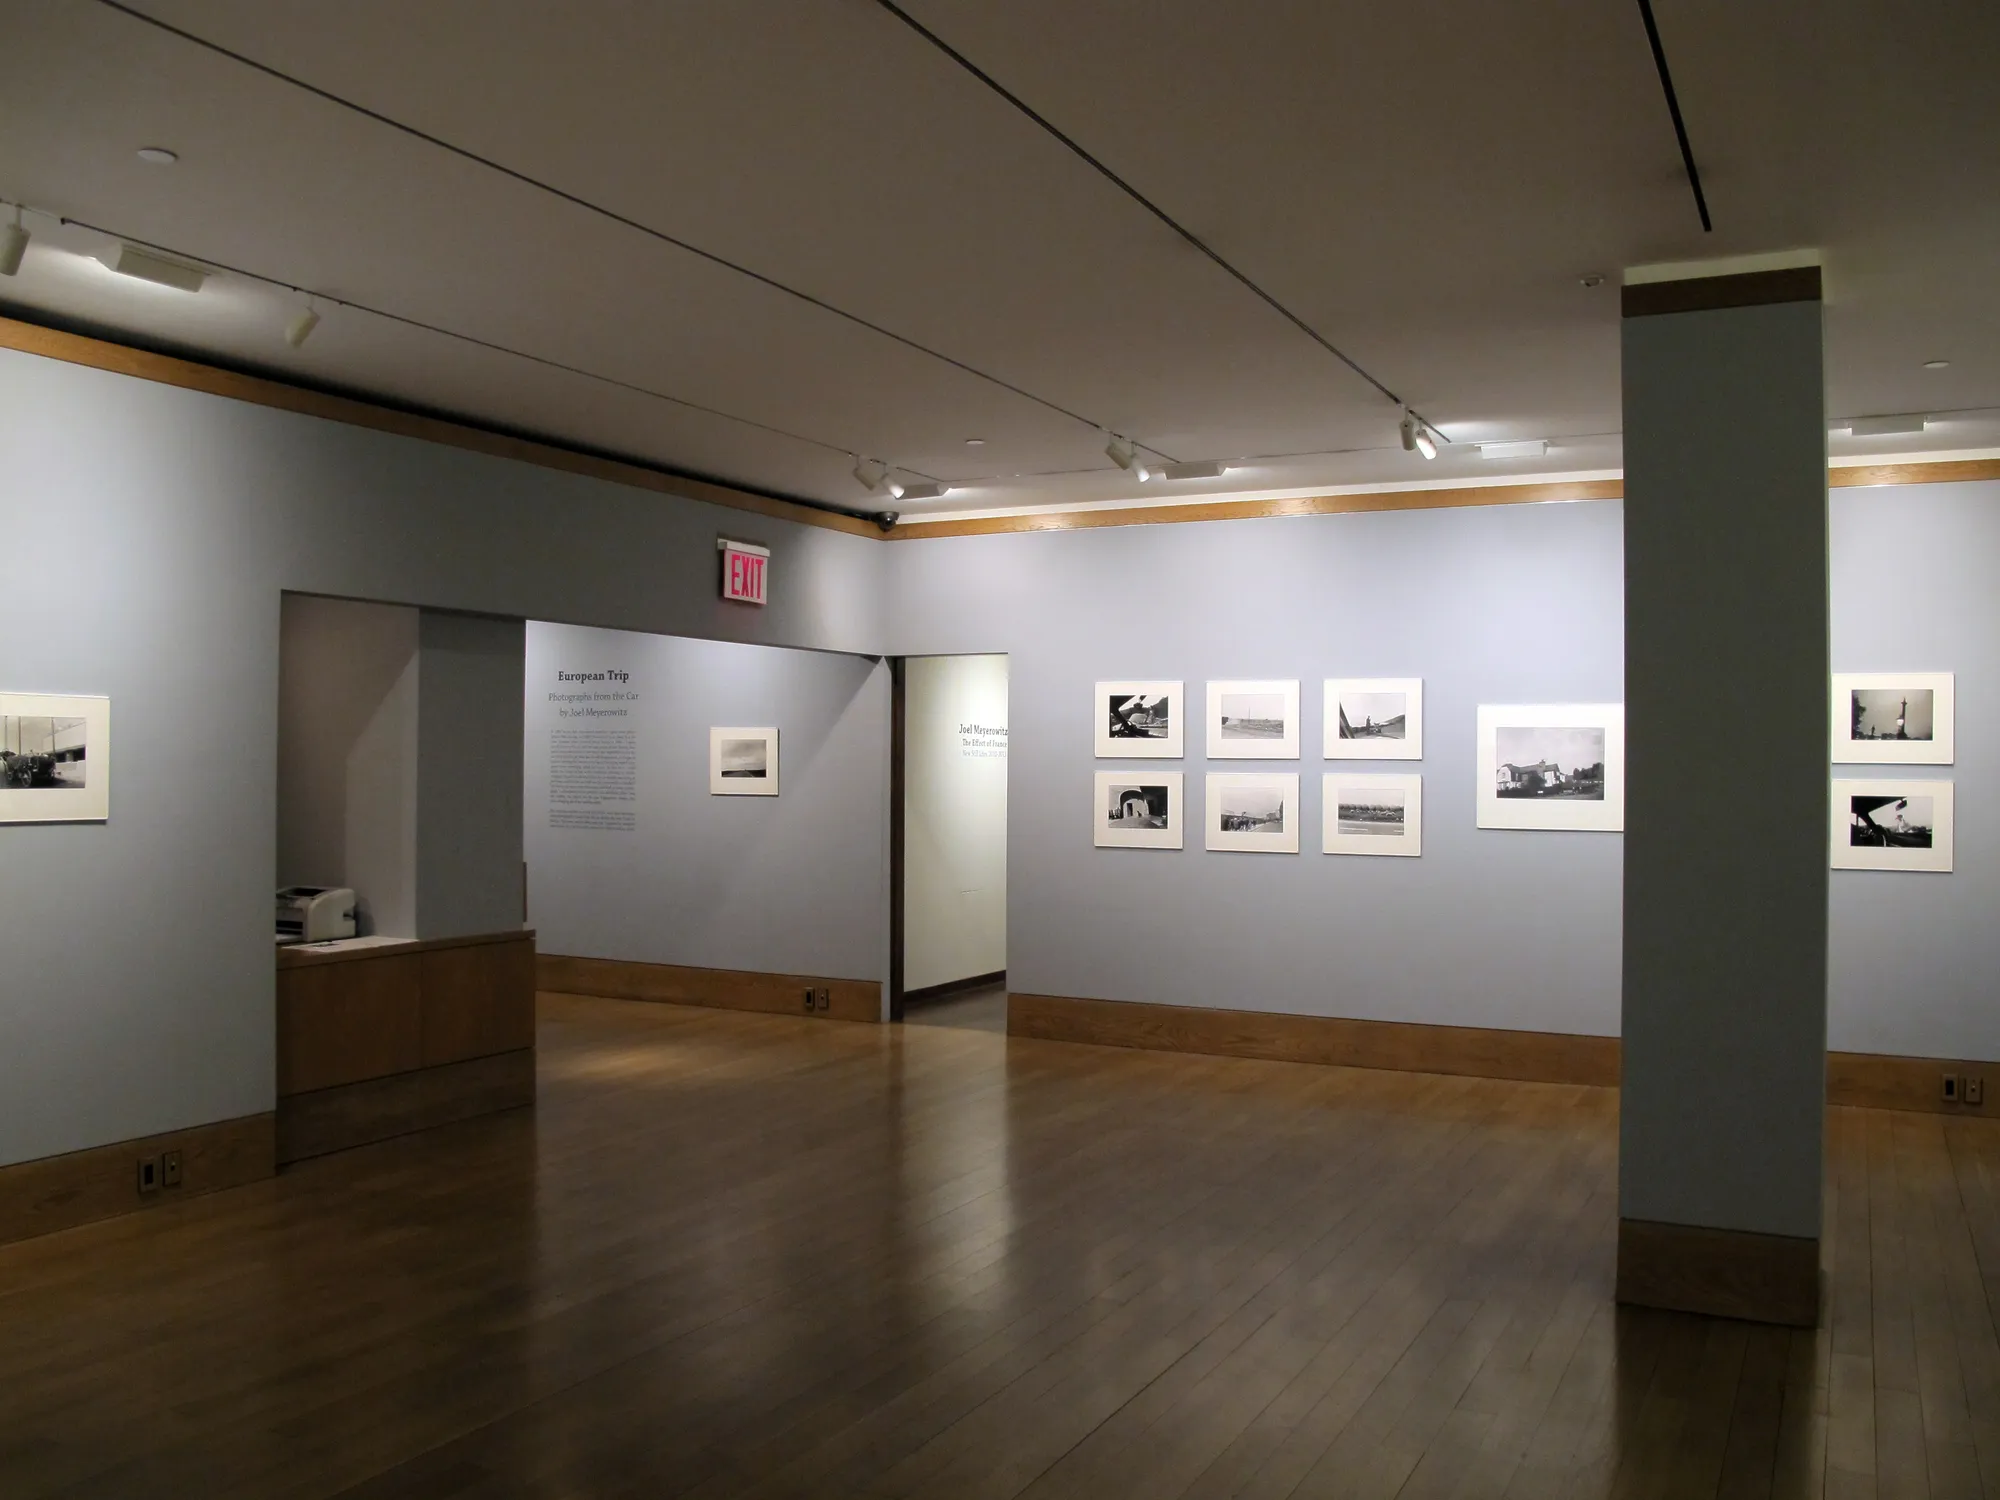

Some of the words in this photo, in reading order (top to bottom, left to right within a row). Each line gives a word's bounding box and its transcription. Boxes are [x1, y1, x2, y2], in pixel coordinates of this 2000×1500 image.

[731, 553, 764, 600] EXIT
[558, 670, 605, 684] European
[607, 670, 629, 684] Trip
[548, 692, 592, 704] Photographs
[593, 691, 611, 701] from
[612, 691, 625, 701] the
[626, 691, 640, 701] Car
[559, 707, 569, 719] by
[570, 707, 584, 718] Joel
[585, 707, 628, 719] Meyerowitz
[959, 723, 973, 735] Joel
[973, 724, 1008, 738] Meyerowitz
